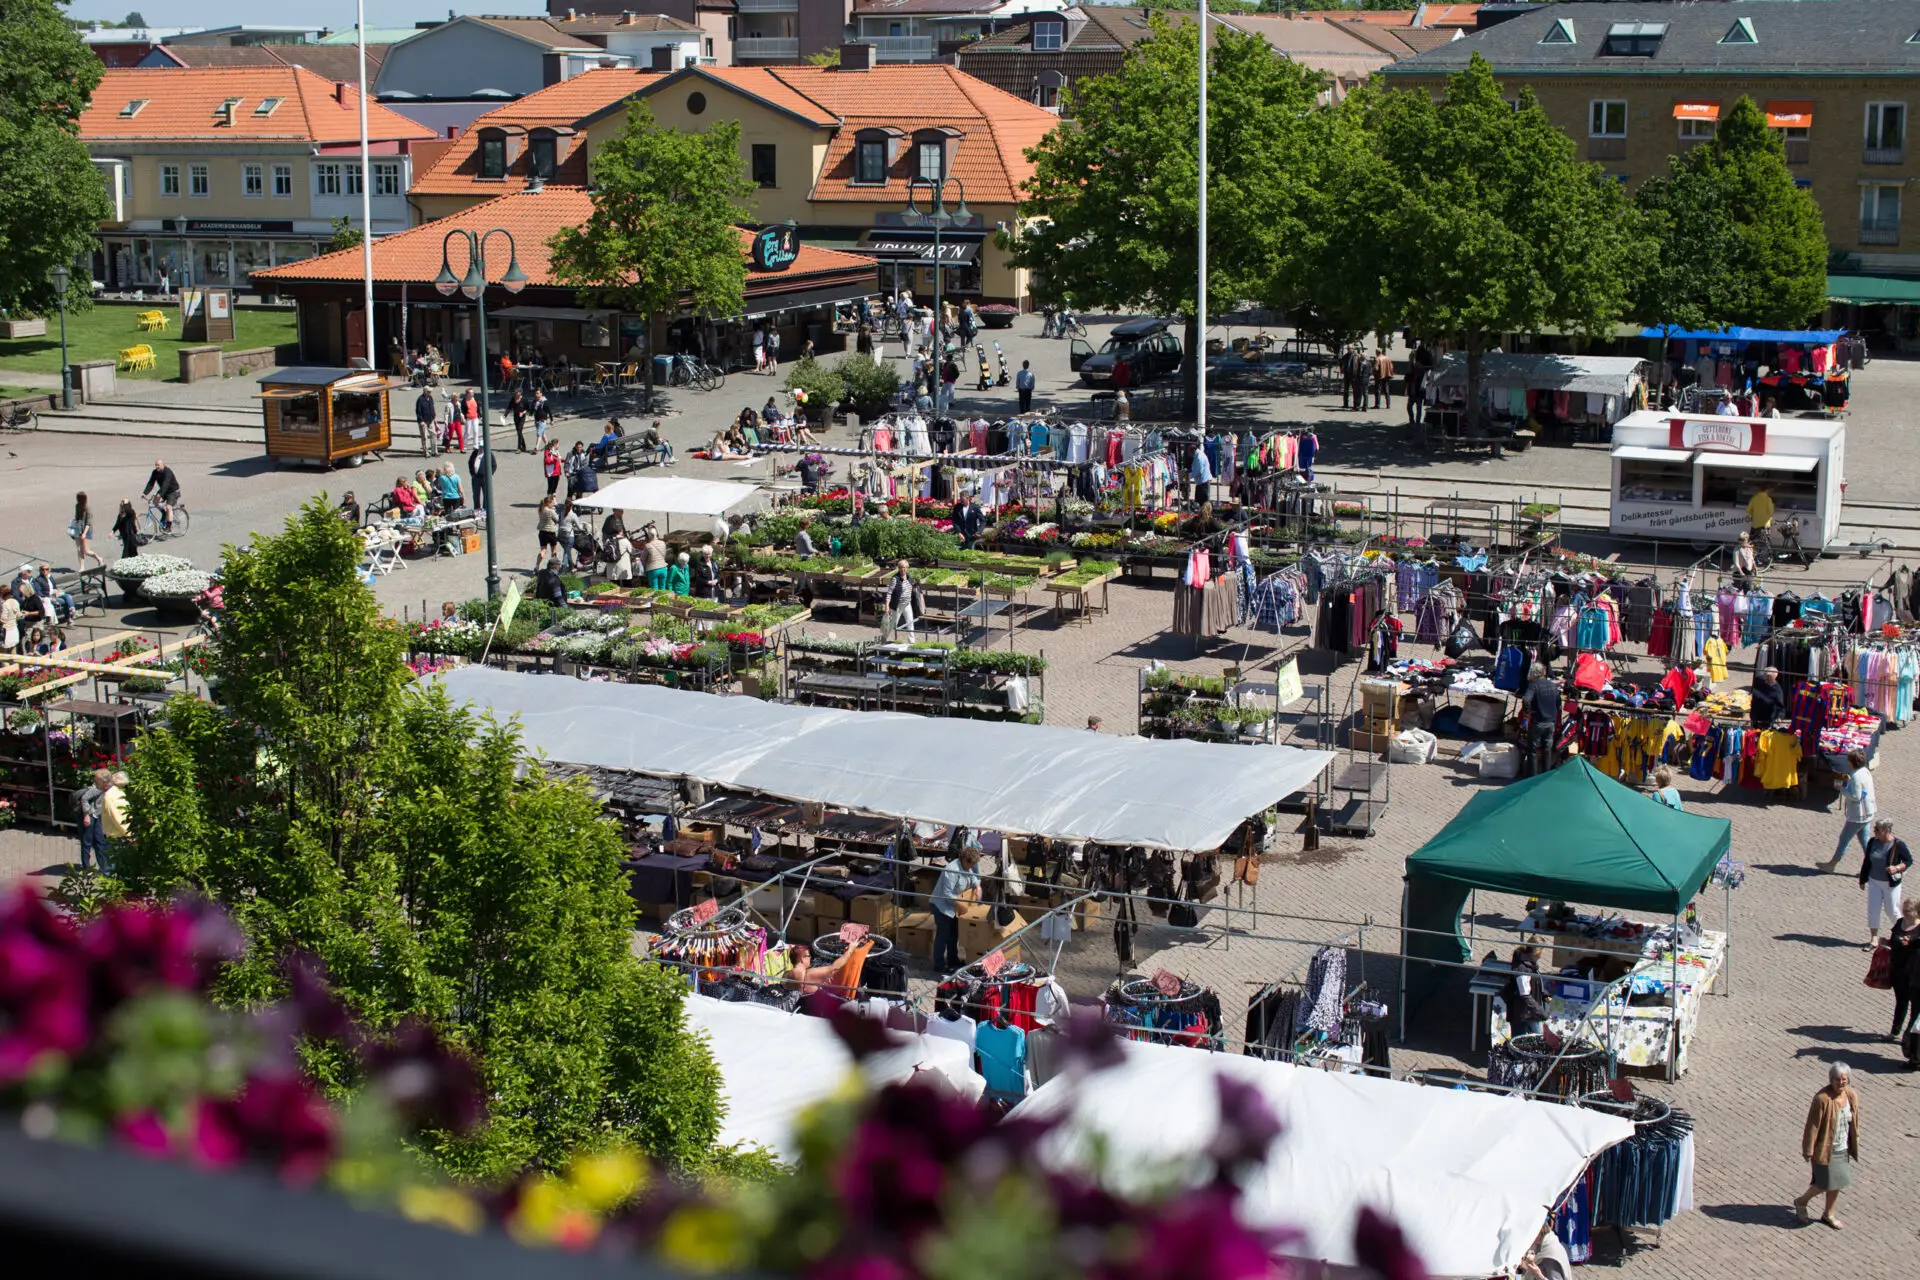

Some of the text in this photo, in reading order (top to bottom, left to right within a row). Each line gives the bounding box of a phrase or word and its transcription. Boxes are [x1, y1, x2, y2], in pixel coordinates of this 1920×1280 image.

[1621, 508, 1674, 522] Delikatesser
[1649, 510, 1725, 527] från gårdsbutiken
[1705, 519, 1716, 530] på
